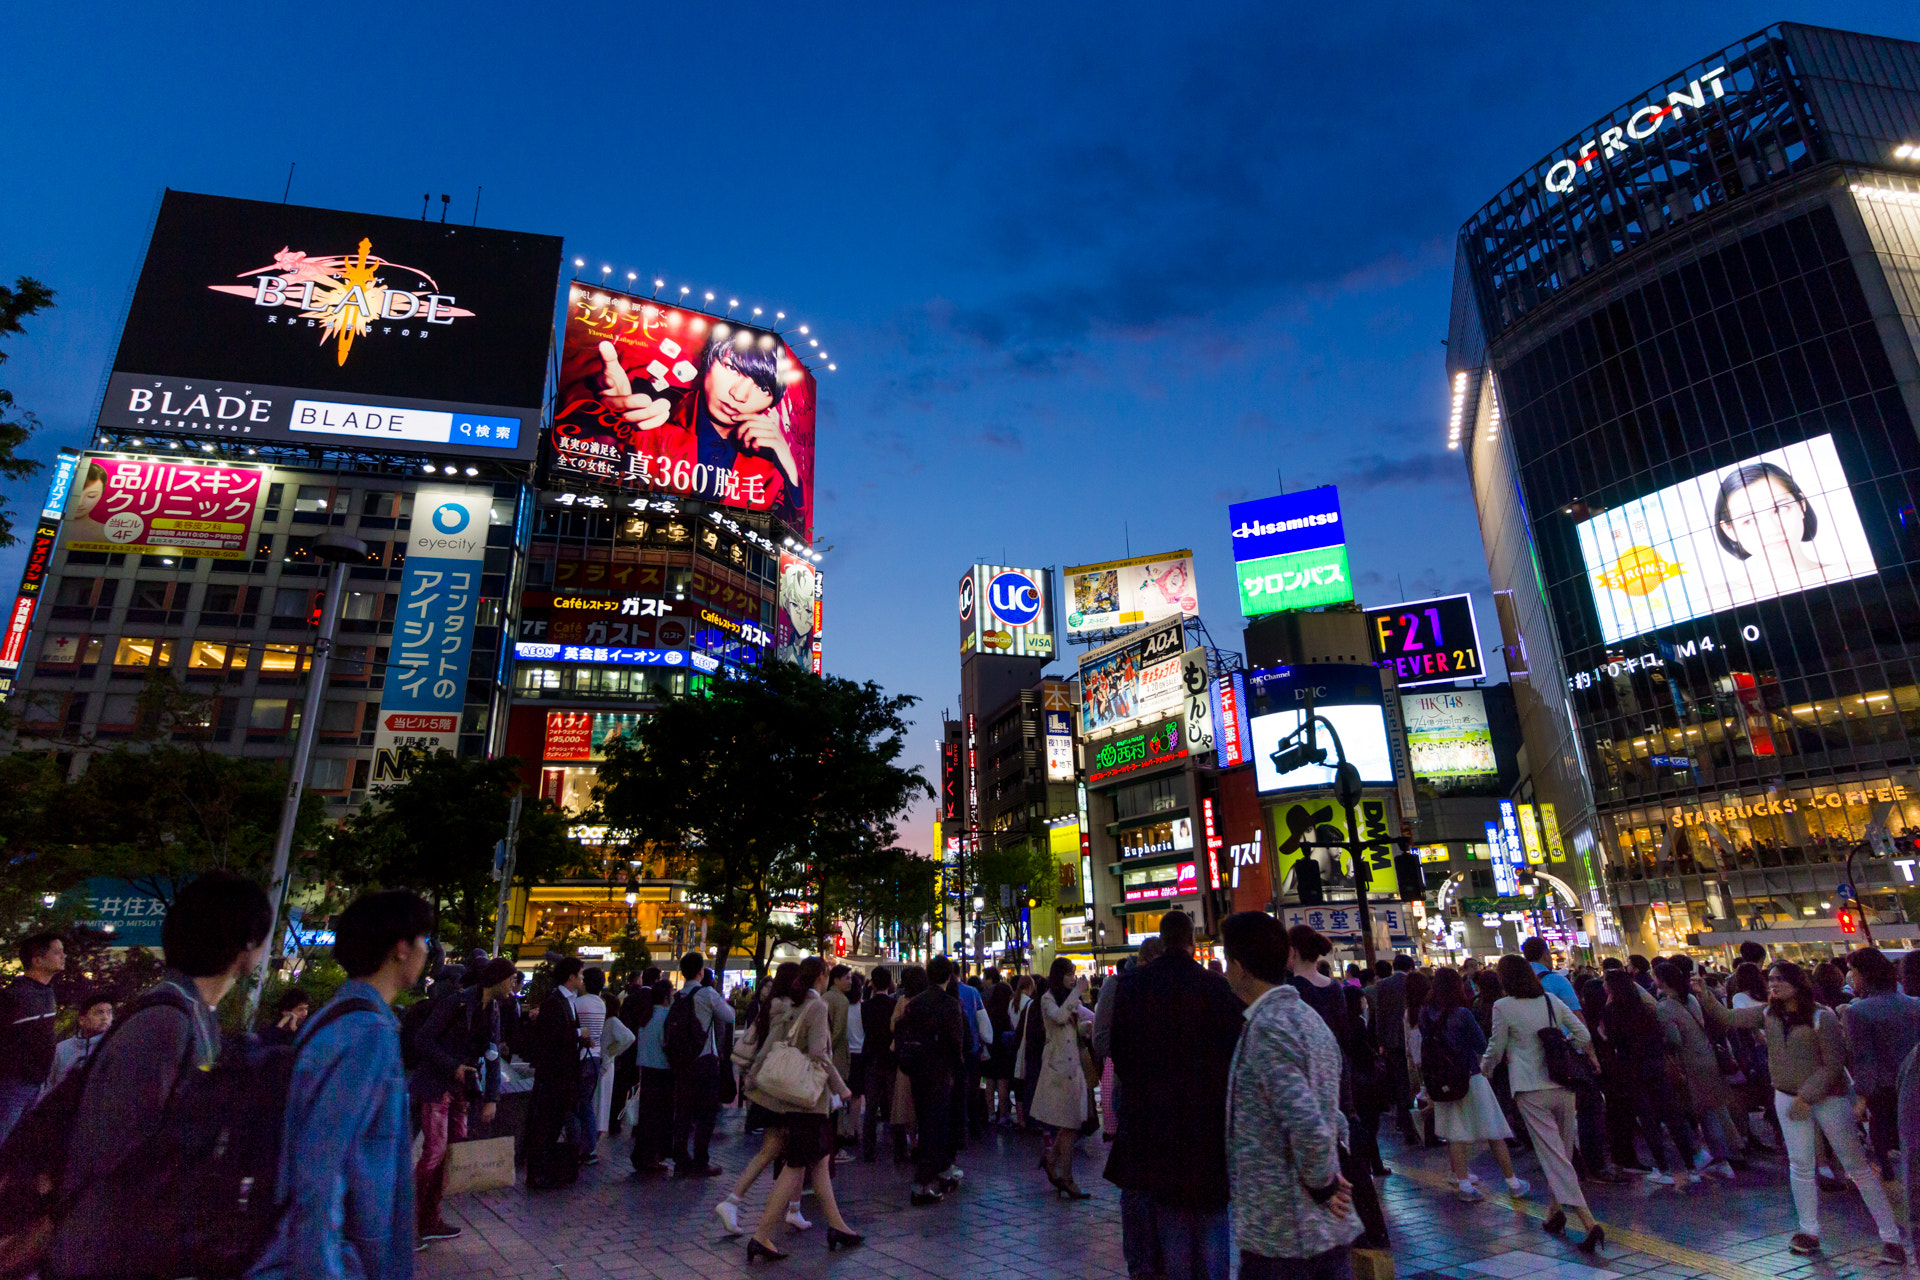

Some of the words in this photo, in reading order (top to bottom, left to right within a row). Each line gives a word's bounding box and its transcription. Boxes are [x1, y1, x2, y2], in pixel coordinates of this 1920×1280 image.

[1545, 66, 1725, 193] QFRONT
[254, 274, 456, 326] BLADE
[574, 302, 667, 341] エタラビ
[128, 388, 272, 423] BLADE
[300, 407, 405, 433] BLADE
[476, 424, 511, 440] 検索
[559, 436, 621, 459] 真実の満足を、
[557, 454, 620, 476] 全ての女性に。
[48, 462, 72, 508] 東急リバブル
[109, 463, 258, 495] 品川スキン
[624, 451, 765, 505] 真360°脱毛
[106, 489, 252, 520] クリニック
[108, 518, 141, 528] 当ビル
[112, 530, 133, 540] 4F
[1232, 511, 1339, 539] Hisamitsu
[418, 537, 476, 551] eyecity
[558, 563, 660, 585] プライス
[1243, 563, 1345, 597] サロンパス
[1609, 561, 1667, 588] STRONG
[693, 573, 758, 613] コンタクト
[993, 584, 1038, 612] UC
[553, 597, 582, 609] Café
[583, 600, 619, 611] レストラン
[621, 597, 673, 617] ガスト
[397, 570, 443, 698] アイシティ
[432, 572, 471, 700] コンタクトの
[522, 620, 548, 635] 7F
[585, 620, 650, 645] ガスト
[741, 623, 771, 648] ガスト
[520, 645, 555, 657] AEON
[564, 646, 661, 663] 英会話イーオン
[1028, 638, 1051, 647] VISA
[1143, 627, 1180, 657] AOA
[1452, 648, 1476, 670] 21
[1263, 670, 1290, 681] Channel
[1183, 660, 1213, 749] もんじゃ
[393, 718, 452, 730] 当ビル5階
[550, 717, 587, 729] ハワイ
[1220, 676, 1239, 760] 三千里薬品
[392, 736, 440, 746] 利用者数
[1117, 741, 1146, 764] 西村
[1391, 738, 1406, 779] neon
[1671, 798, 1798, 828] STARBUCKS
[1810, 785, 1908, 810] COFFEE
[1123, 840, 1172, 858] Euphoria
[126, 920, 156, 928] MITSUI
